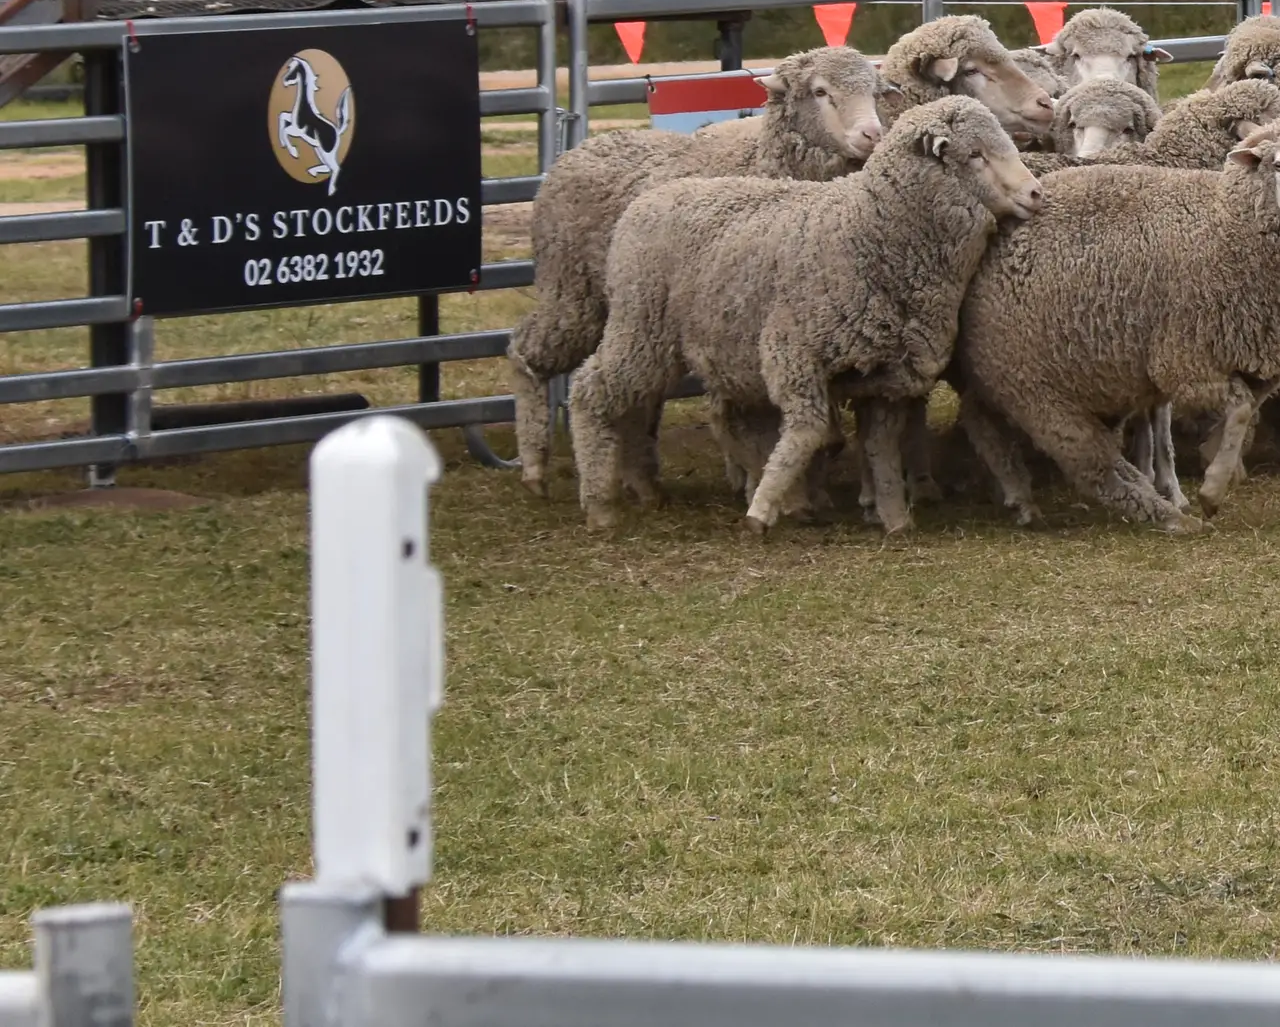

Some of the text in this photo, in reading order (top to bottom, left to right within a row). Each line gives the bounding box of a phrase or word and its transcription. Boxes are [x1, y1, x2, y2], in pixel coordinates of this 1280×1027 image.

[145, 196, 471, 249] T & D'S STOCKFEEDS
[244, 249, 384, 286] 02 6382 1932
